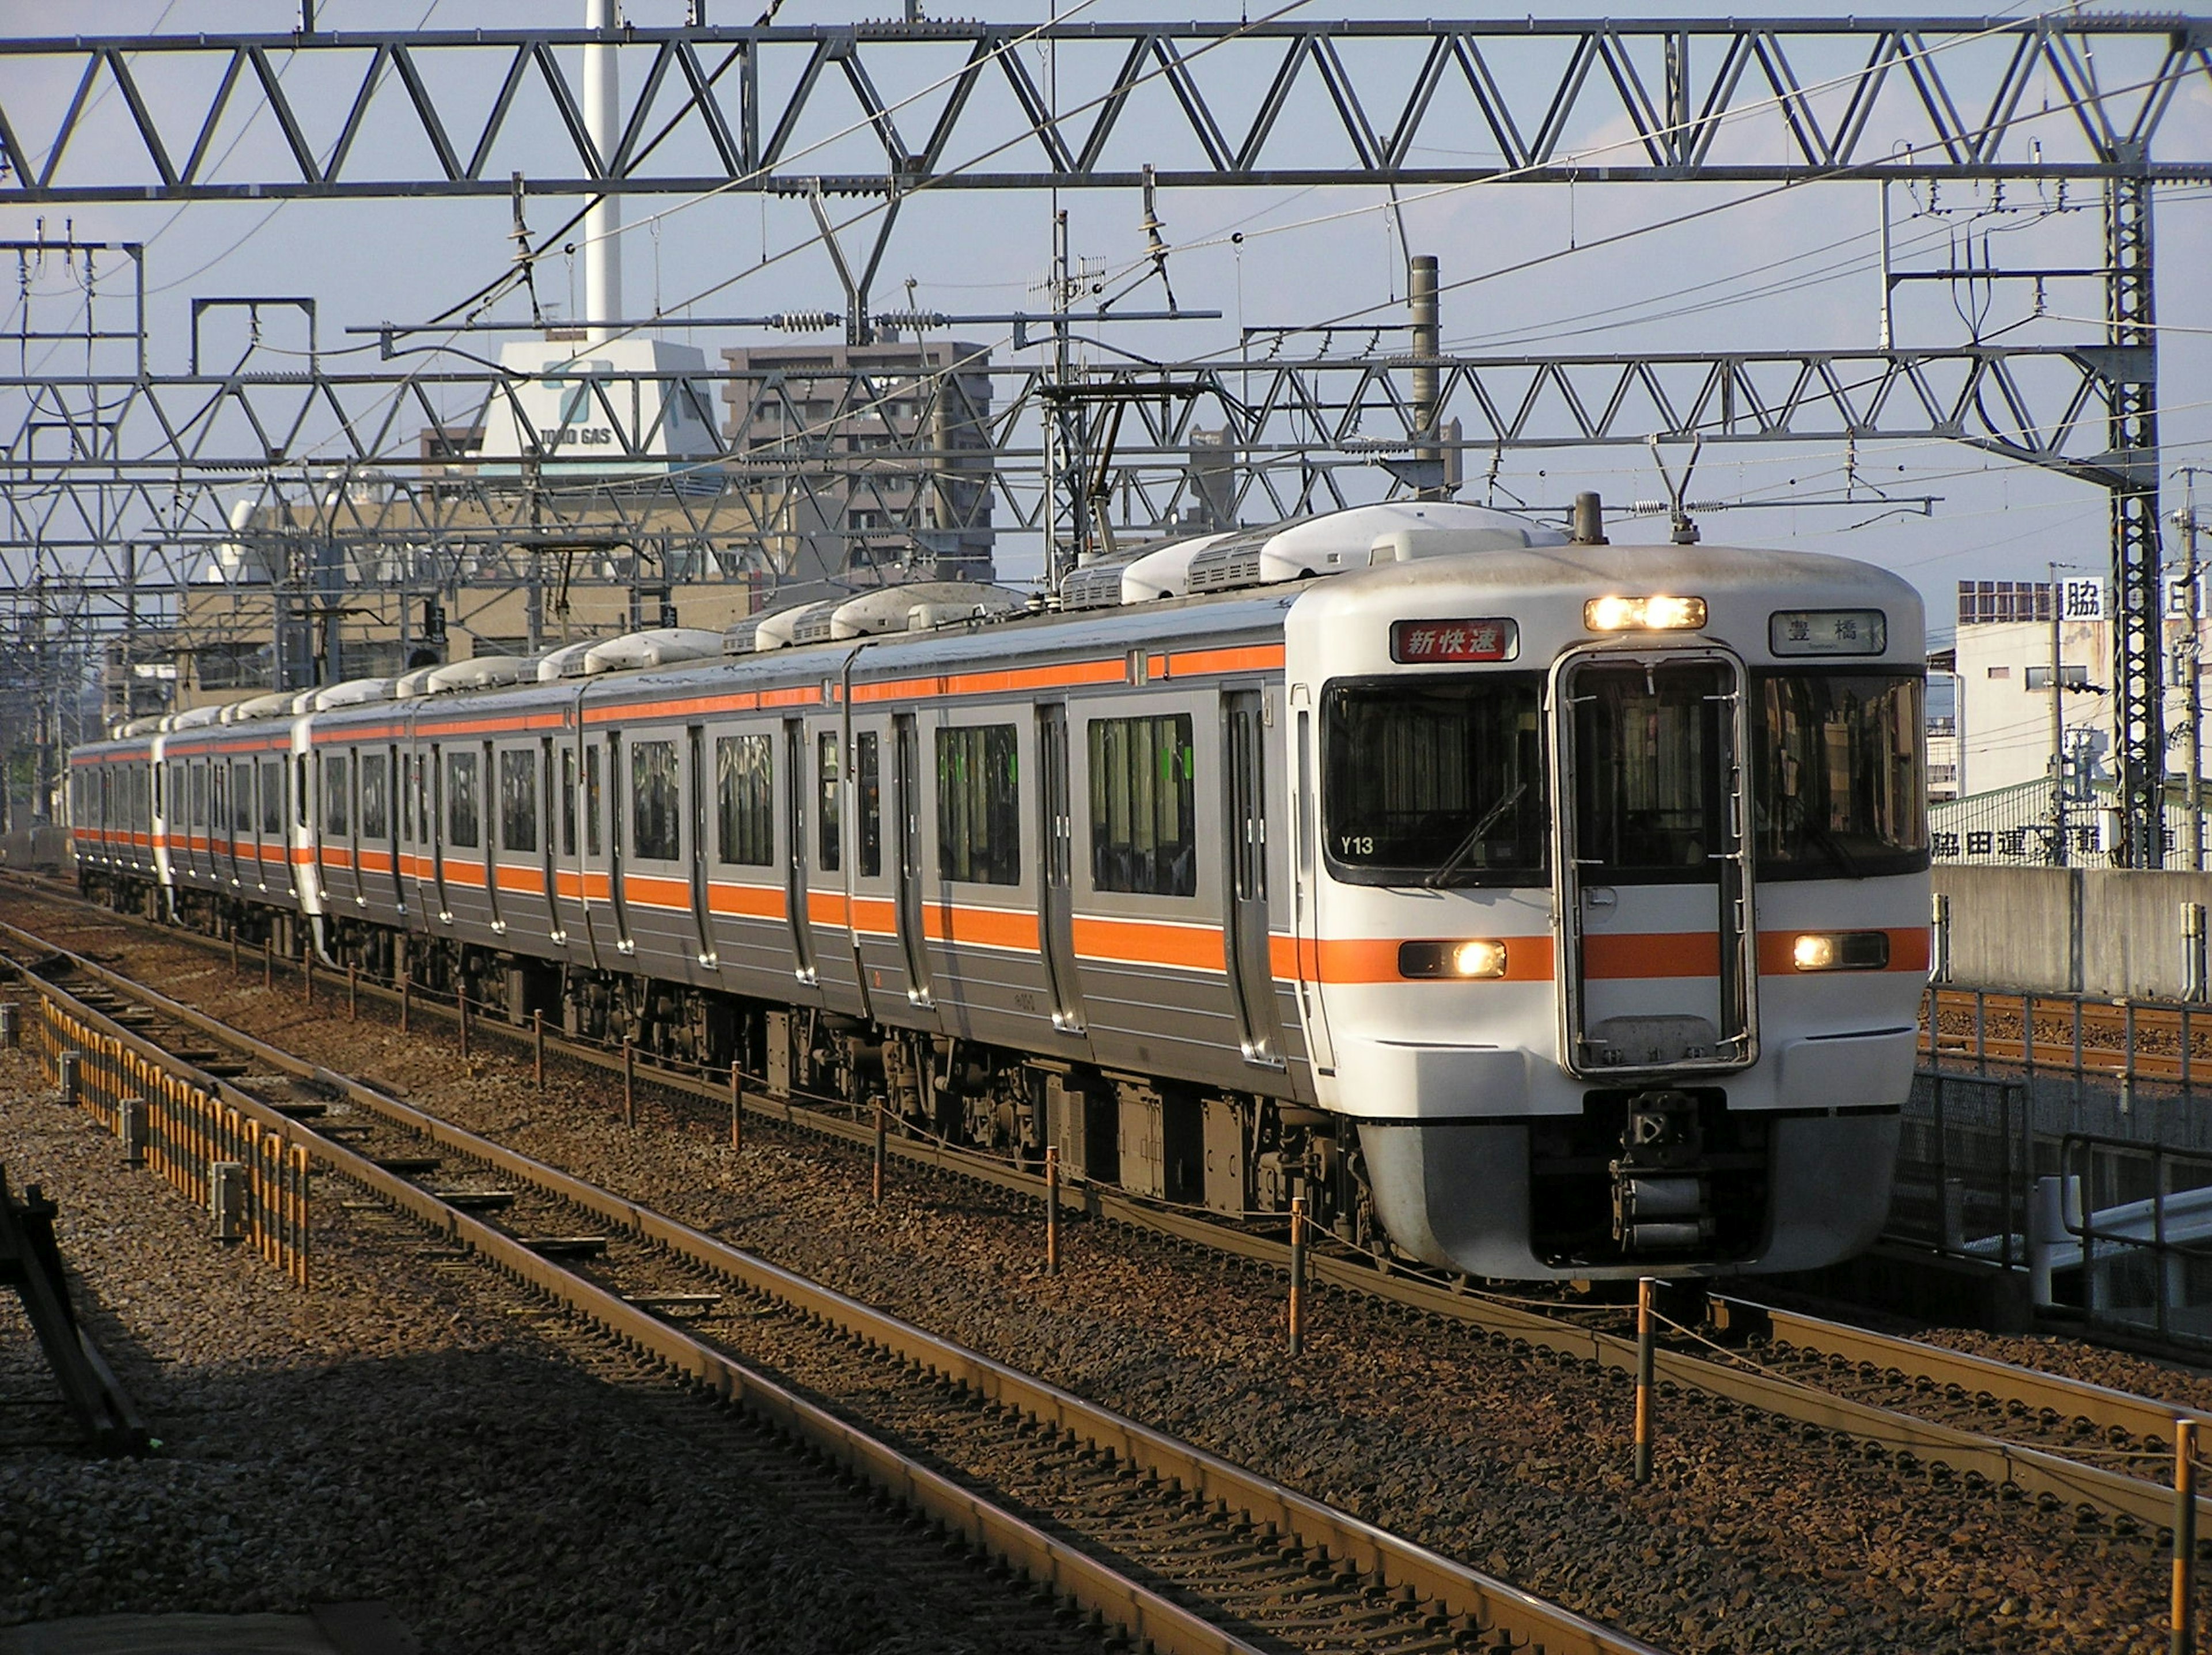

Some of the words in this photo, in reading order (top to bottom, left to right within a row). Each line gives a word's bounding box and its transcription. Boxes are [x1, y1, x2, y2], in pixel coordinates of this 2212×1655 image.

[540, 429, 577, 445] TOO
[581, 428, 611, 445] GAS
[1789, 619, 1857, 641] 豊橋
[1408, 628, 1498, 654] 新快速
[1341, 836, 1374, 854] Y13
